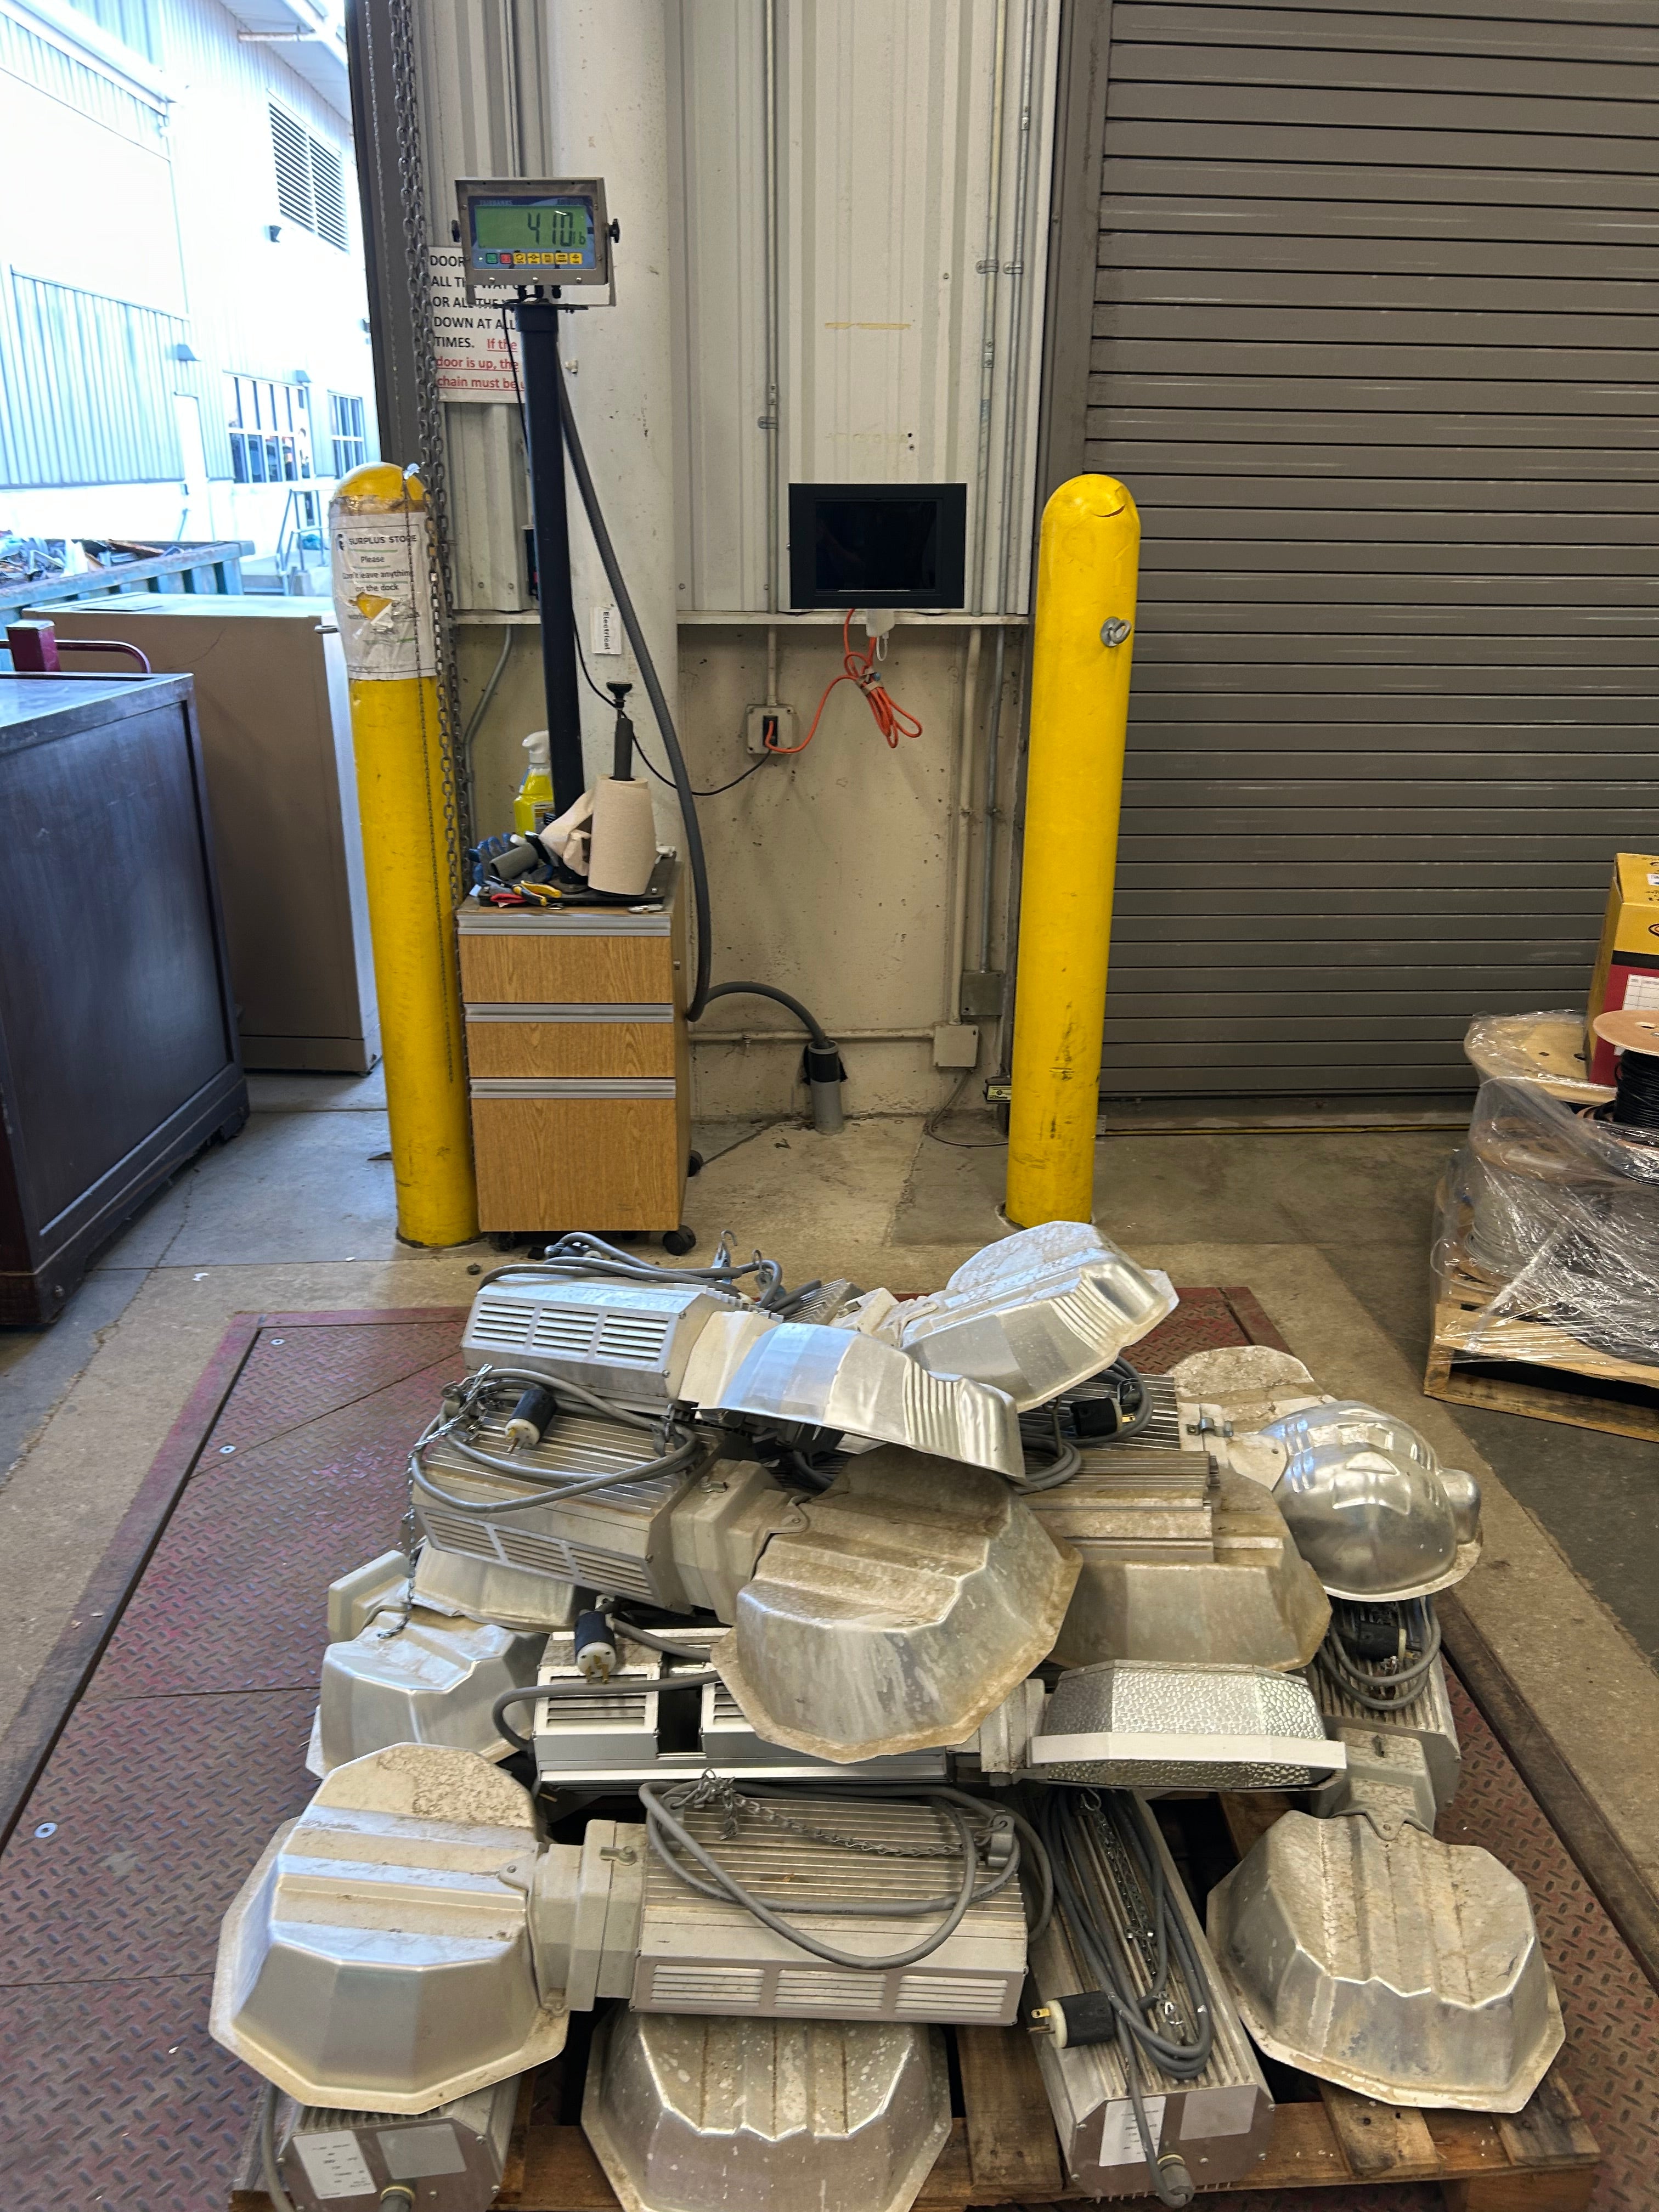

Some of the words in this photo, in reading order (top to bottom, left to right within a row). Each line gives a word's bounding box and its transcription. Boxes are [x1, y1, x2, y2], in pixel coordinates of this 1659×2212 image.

[431, 276, 452, 287] ALL
[432, 296, 450, 307] OR
[433, 317, 473, 328] DOWN
[477, 319, 492, 329] AT
[434, 337, 475, 348] TIMES.
[487, 338, 495, 349] If
[498, 339, 517, 350] the
[436, 356, 463, 368] door
[466, 357, 475, 368] is
[478, 360, 497, 370] up,
[500, 358, 519, 370] the
[436, 375, 468, 387] chain
[471, 378, 500, 388] must
[503, 378, 516, 389] be
[348, 537, 386, 545] SURPLUS
[380, 569, 413, 579] anythin
